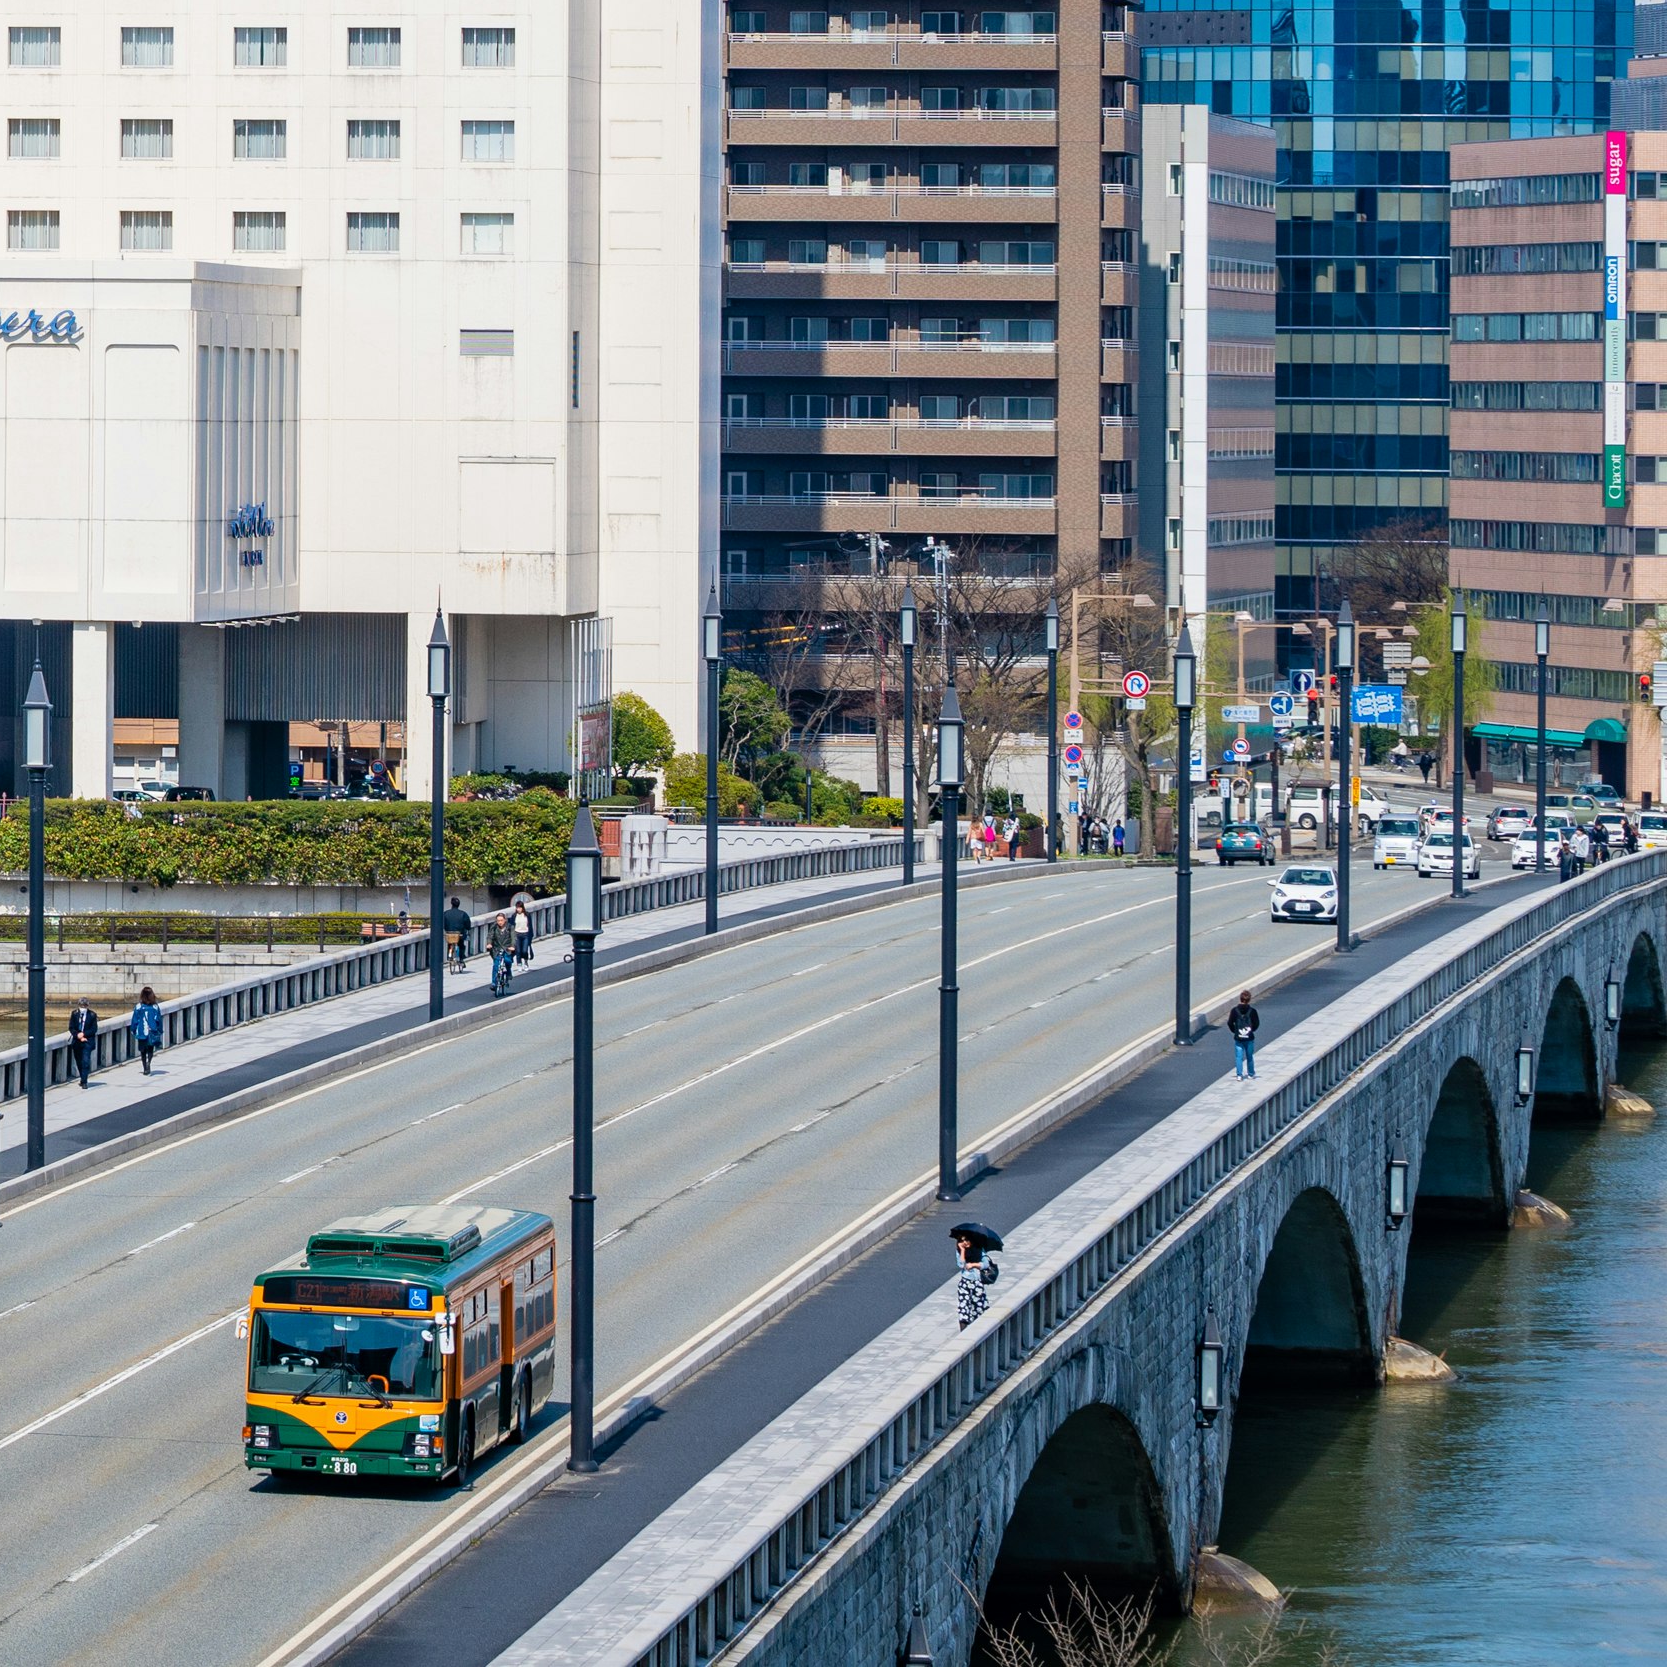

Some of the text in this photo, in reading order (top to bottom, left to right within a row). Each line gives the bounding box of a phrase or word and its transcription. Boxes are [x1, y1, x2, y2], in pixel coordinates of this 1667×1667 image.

[1610, 142, 1623, 185] sugar
[1611, 326, 1621, 376] innocently
[1609, 454, 1622, 500] Chacott
[290, 765, 299, 776] P
